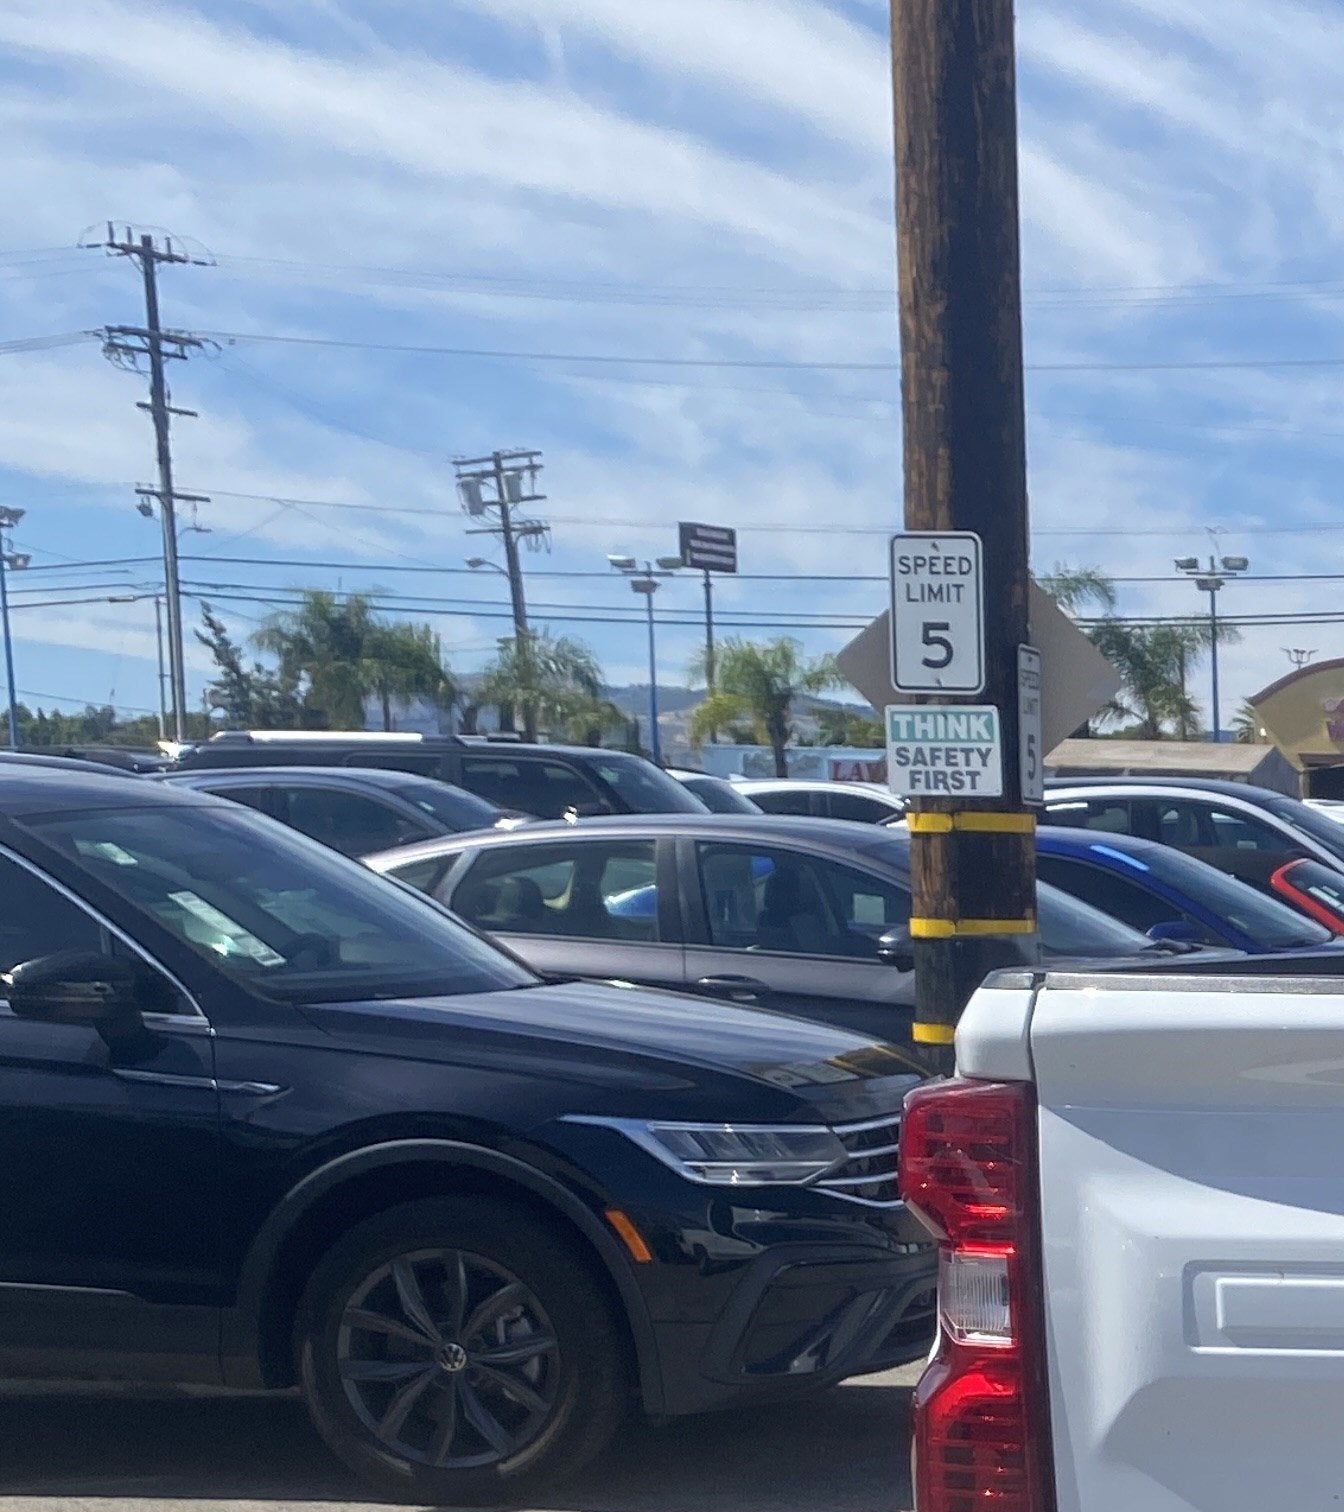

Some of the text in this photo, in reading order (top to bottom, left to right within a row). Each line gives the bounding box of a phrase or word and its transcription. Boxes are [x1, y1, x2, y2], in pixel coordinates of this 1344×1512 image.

[898, 555, 972, 575] SPEED
[906, 583, 964, 603] LIMIT
[921, 622, 954, 669] 5
[893, 714, 991, 740] THINK
[896, 746, 992, 767] SAFETY
[909, 770, 981, 790] FIRST
